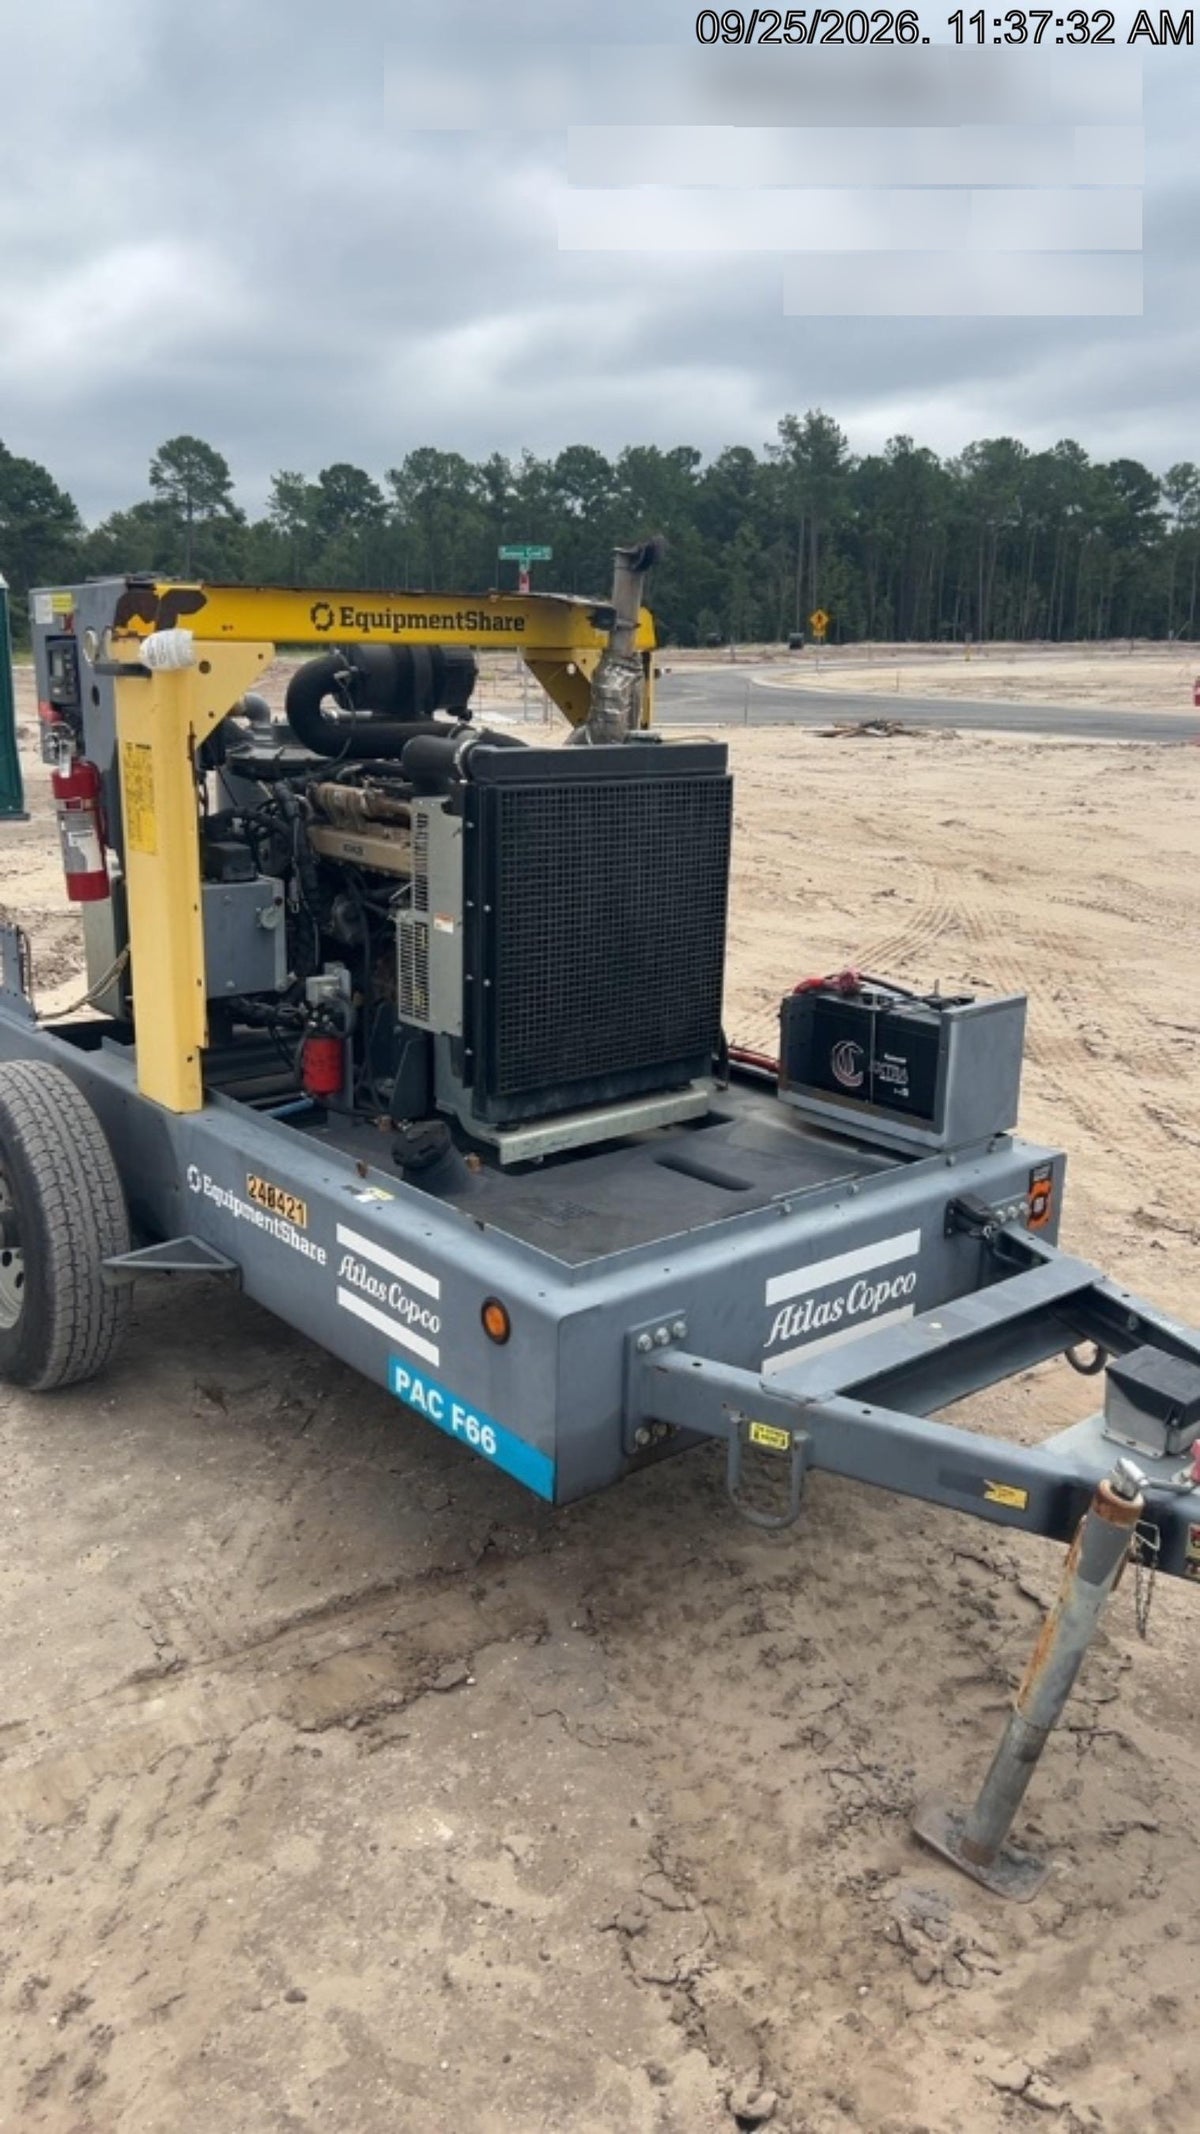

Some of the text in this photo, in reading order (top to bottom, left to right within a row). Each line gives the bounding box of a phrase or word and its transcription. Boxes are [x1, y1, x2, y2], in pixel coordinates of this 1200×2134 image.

[340, 606, 525, 633] EquipmentShare
[203, 1175, 327, 1266] EquipmentShare
[338, 1255, 441, 1334] Atlas Copco
[763, 1271, 917, 1348] Atlas Copco
[395, 1366, 497, 1455] PAC F66
